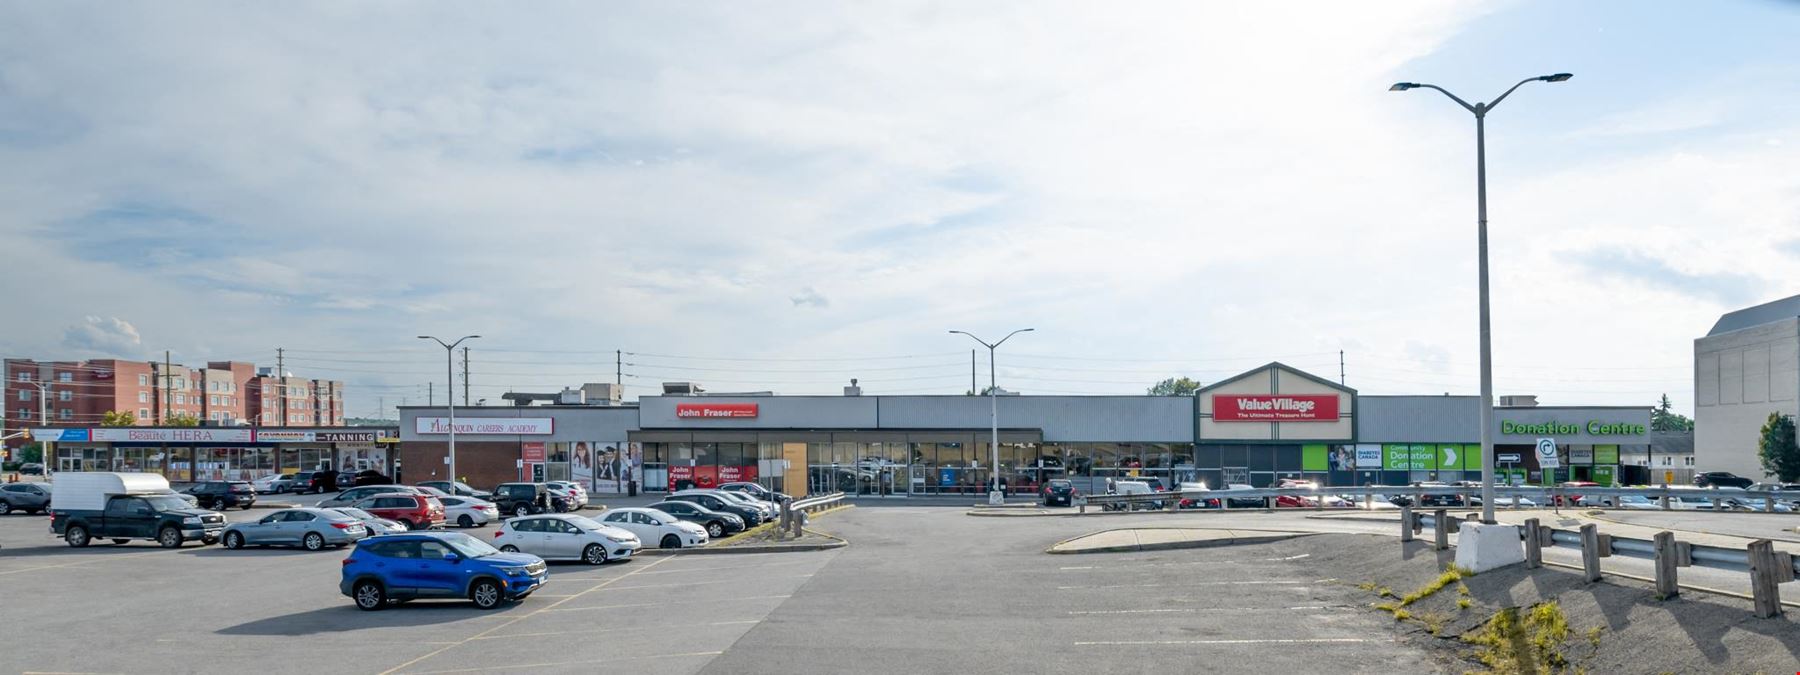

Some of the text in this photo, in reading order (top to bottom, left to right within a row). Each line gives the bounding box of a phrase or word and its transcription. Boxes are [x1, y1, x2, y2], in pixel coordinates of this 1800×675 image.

[1237, 398, 1315, 413] Value Village
[678, 409, 701, 417] John
[703, 408, 733, 417] Fraser
[430, 418, 474, 433] ALGNQUIN
[507, 424, 538, 433] ACADEMY
[1502, 420, 1645, 435] Donation Centre
[172, 430, 213, 440] HERA
[326, 433, 374, 441] TANNING
[1390, 451, 1433, 459] Donation
[1390, 460, 1425, 469] Centre
